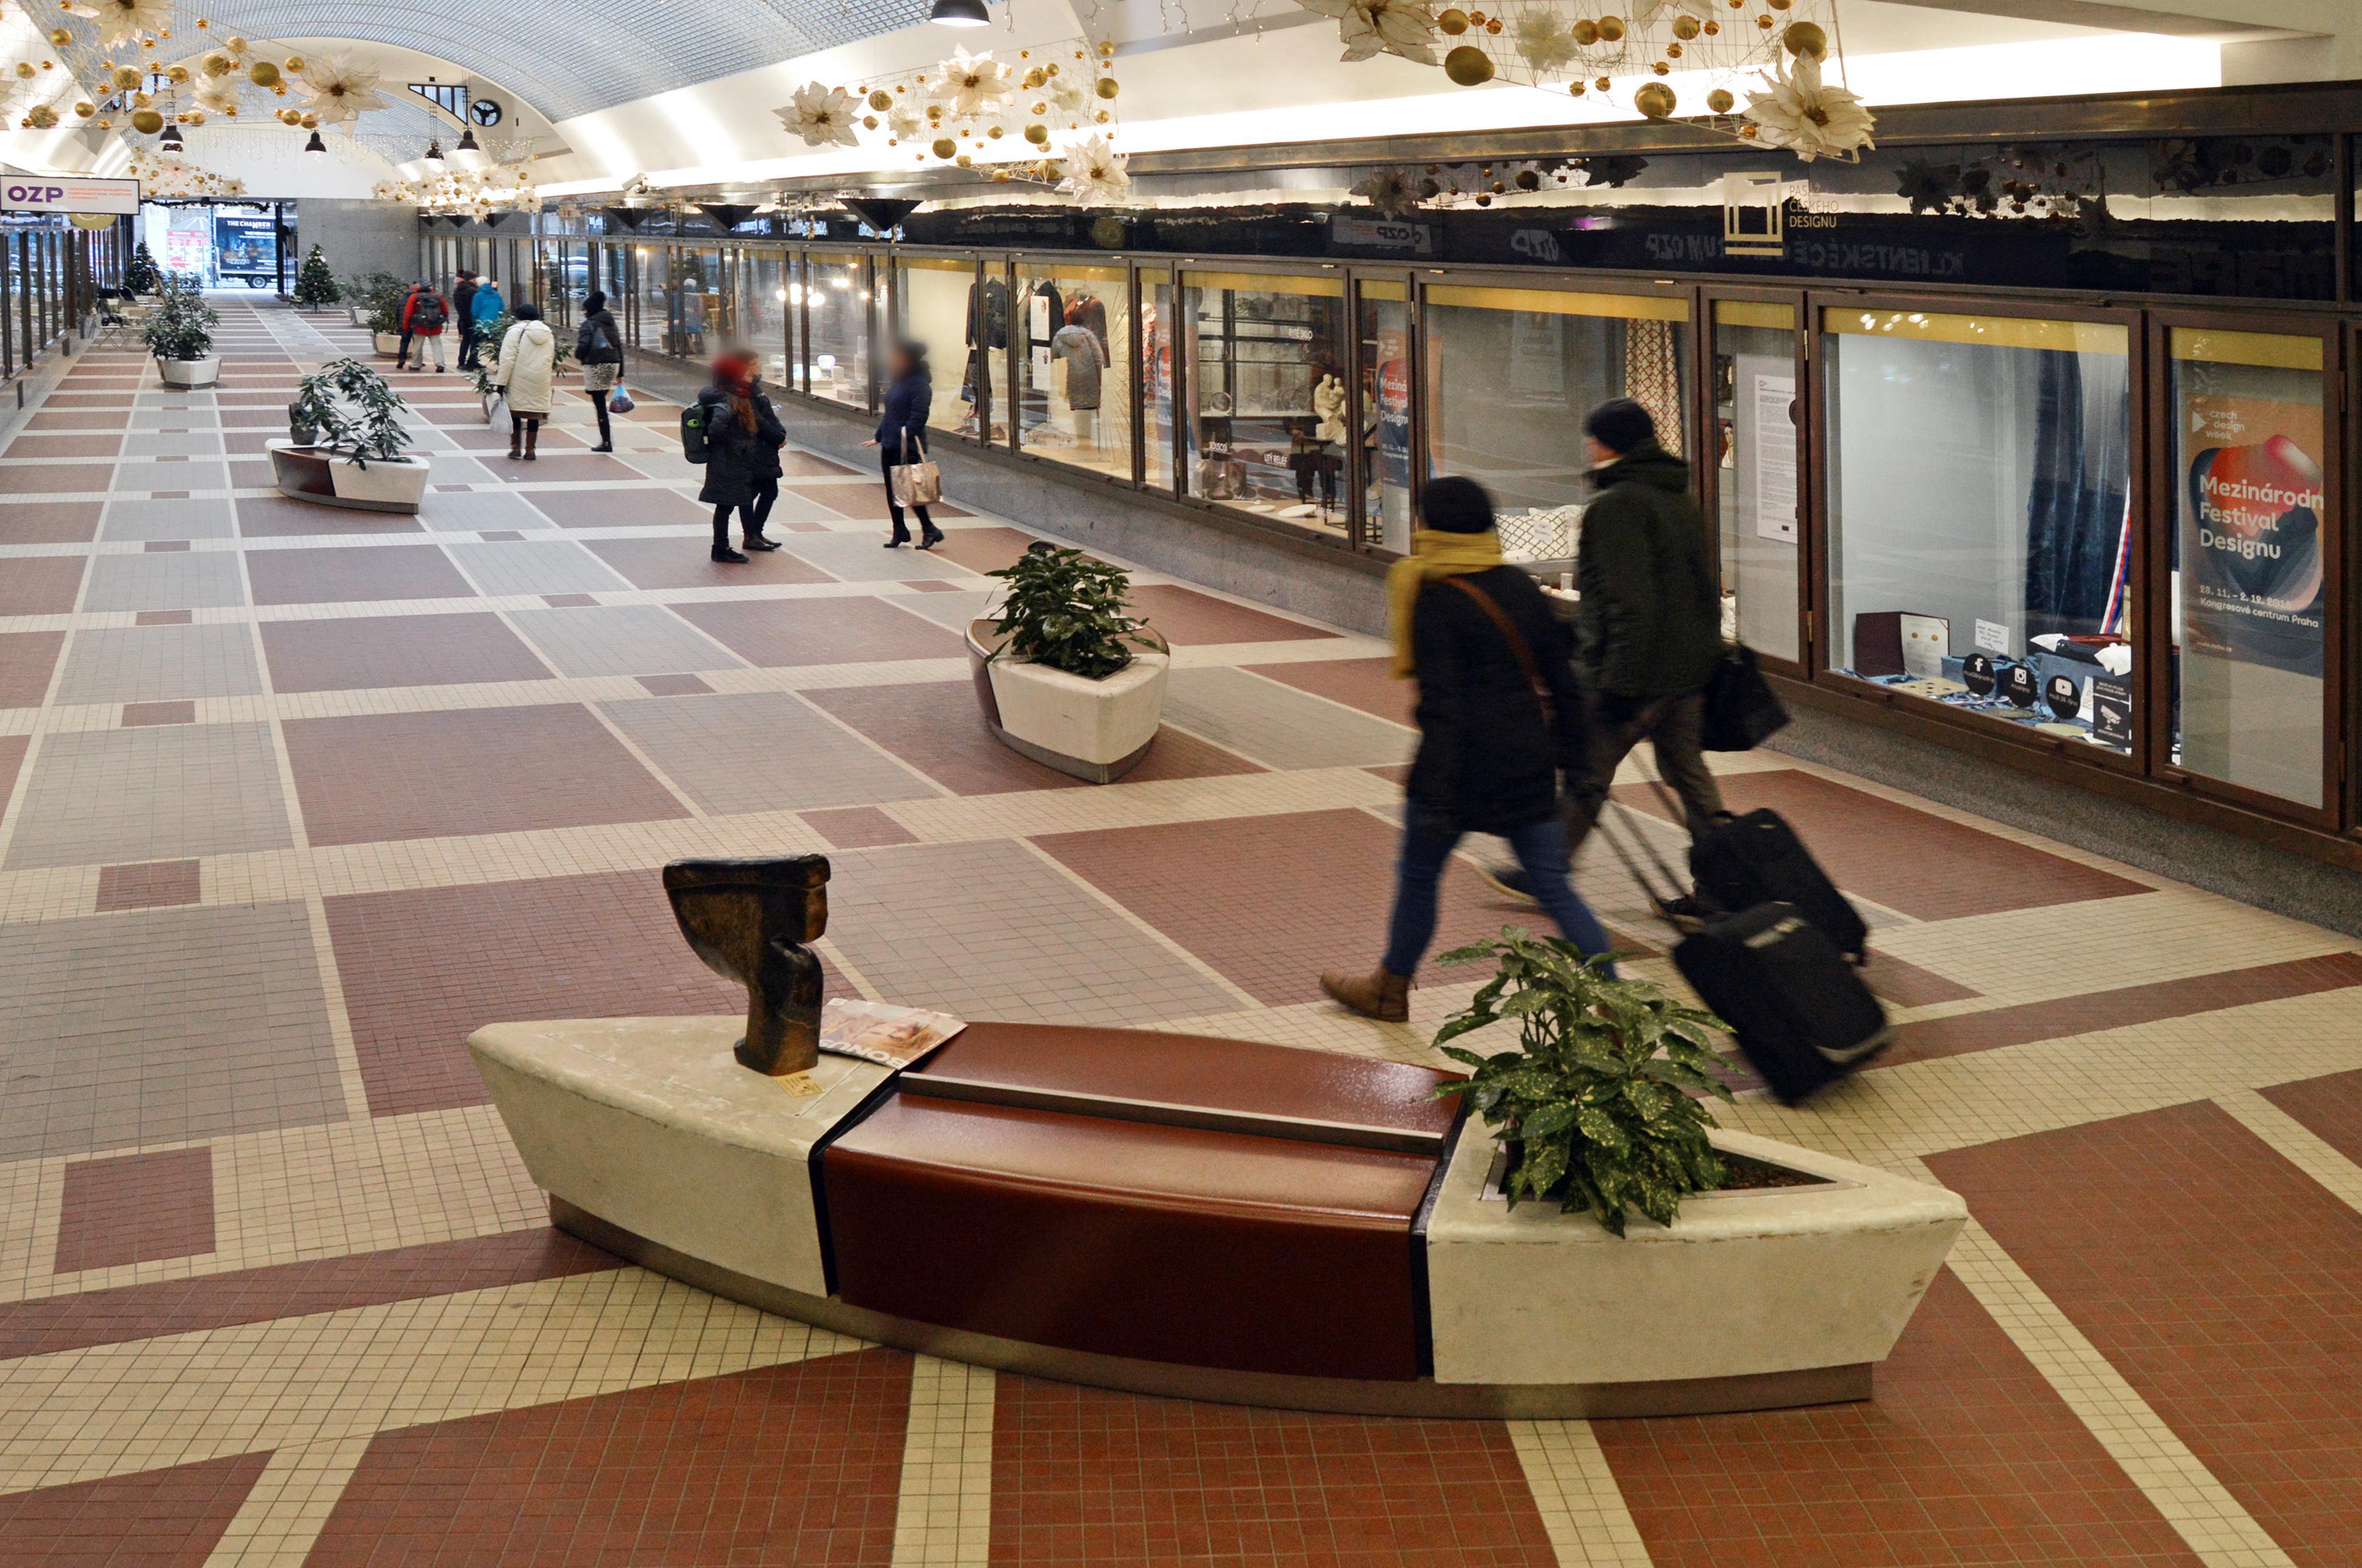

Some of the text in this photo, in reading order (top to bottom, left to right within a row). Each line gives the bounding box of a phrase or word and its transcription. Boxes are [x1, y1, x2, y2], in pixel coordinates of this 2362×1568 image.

[8, 186, 63, 203] OZP
[1790, 183, 1821, 196] PASÁŽ
[1789, 197, 1839, 212] ČESKÉHO
[1790, 215, 1837, 228] DESIGNU
[2210, 410, 2237, 420] czech
[2213, 419, 2245, 433] design
[2205, 430, 2232, 441] week
[2200, 501, 2279, 532] Festival
[2200, 529, 2281, 560] Designu
[2200, 597, 2319, 628] Kongresové centrum Praha
